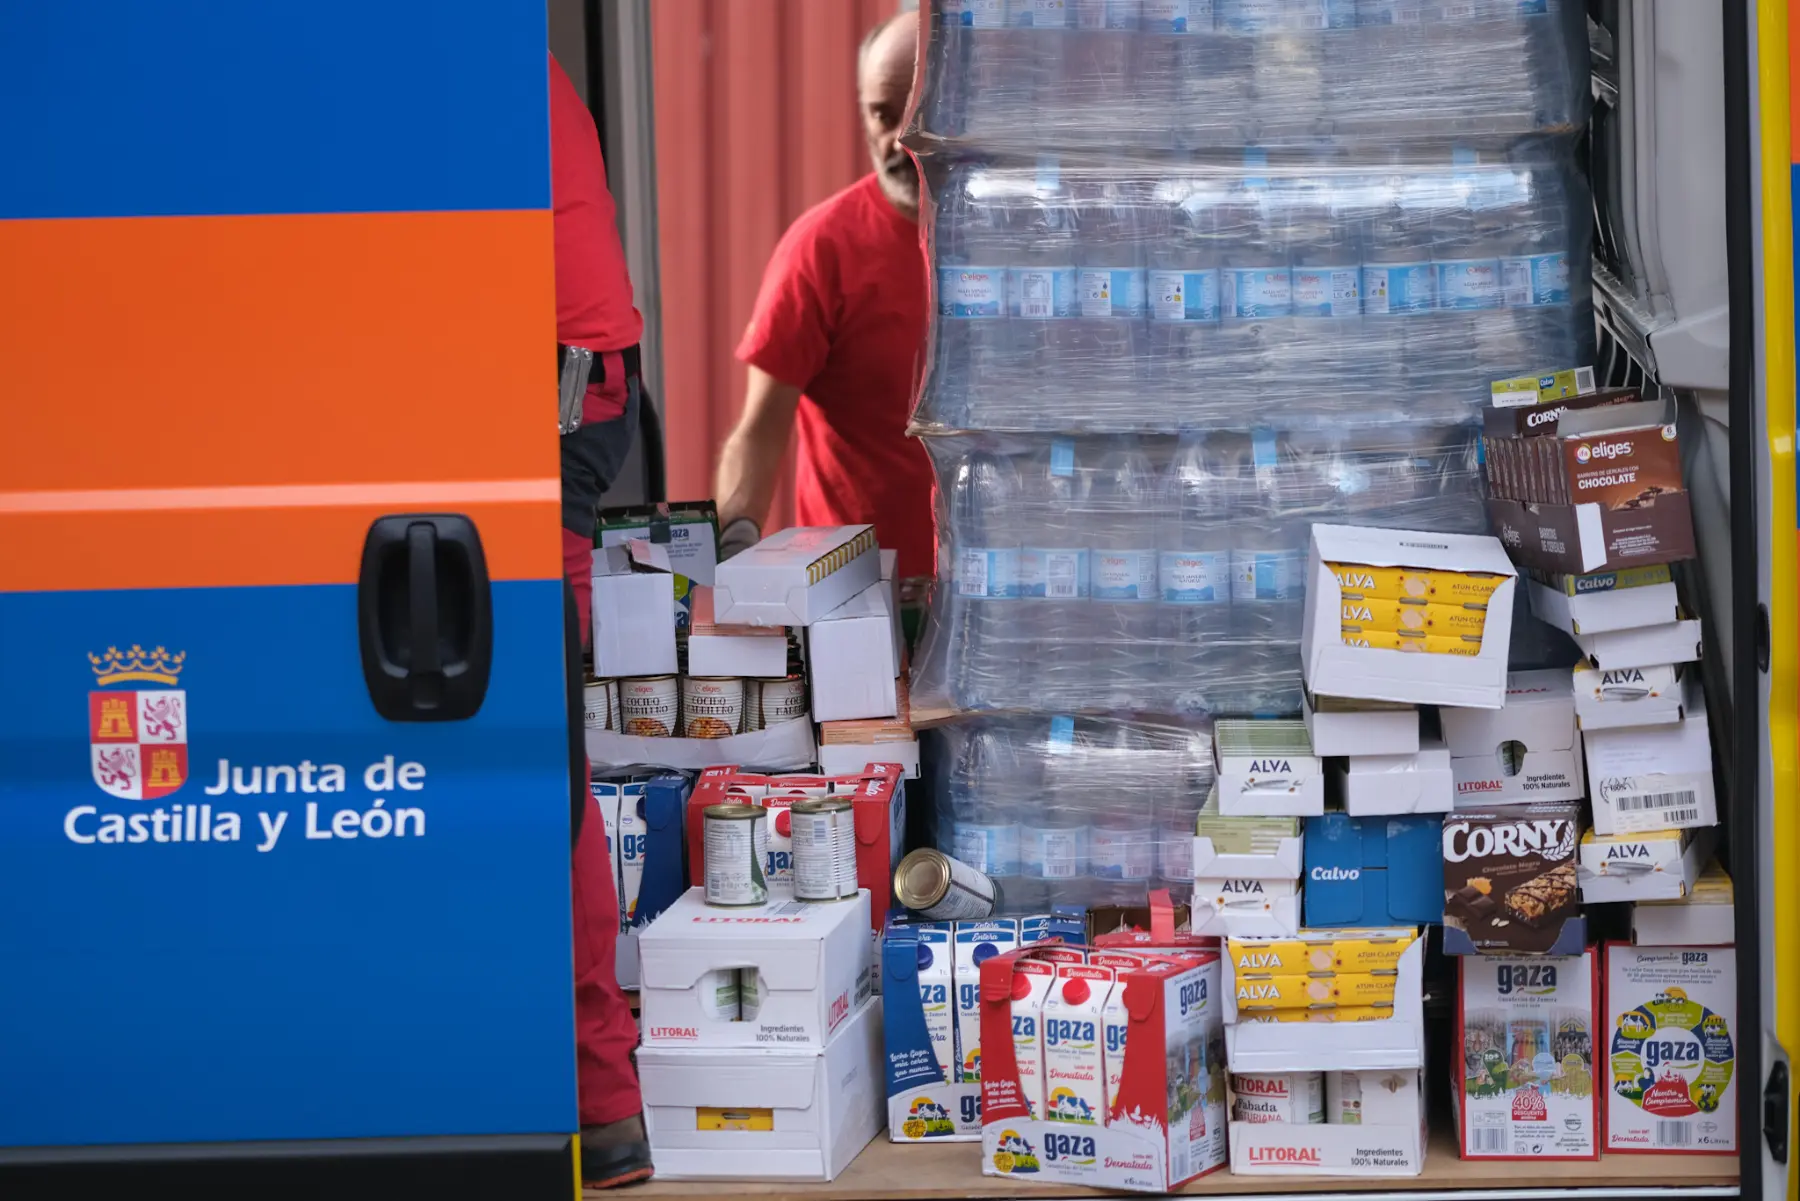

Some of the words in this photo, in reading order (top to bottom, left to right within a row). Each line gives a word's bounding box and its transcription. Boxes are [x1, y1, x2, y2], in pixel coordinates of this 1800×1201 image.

[1592, 442, 1632, 459] eliges
[1578, 473, 1636, 490] CHOCOLATE
[672, 528, 689, 538] aza
[1576, 575, 1614, 590] Calvo
[1343, 605, 1373, 621] LVA
[1601, 669, 1645, 685] ALVA
[1249, 760, 1292, 773] ALVA
[204, 758, 346, 796] Junta
[363, 755, 426, 791] de
[1526, 773, 1565, 782] Ingredientes
[1457, 781, 1503, 792] LITORAL
[1522, 782, 1540, 790] 100%
[1541, 781, 1571, 789] Naturales
[63, 804, 242, 844] Castilla
[256, 811, 288, 853] y
[305, 799, 426, 840] León
[1442, 819, 1566, 863] CORNY
[1607, 844, 1650, 859] ALVA
[1311, 867, 1360, 880] Calvo
[1221, 880, 1264, 894] ALVA
[972, 933, 998, 942] Entera
[1098, 957, 1134, 967] Desnatada
[1239, 953, 1283, 968] ALVA
[1682, 952, 1708, 965] gaza
[1066, 968, 1103, 979] Desnatada
[1497, 964, 1557, 995] gaza
[921, 984, 946, 1003] za
[1180, 978, 1207, 1016] gaza
[1237, 984, 1281, 1000] ALVA
[650, 1027, 698, 1037] LITORAL
[760, 1024, 805, 1034] Ingredientes
[1013, 1016, 1035, 1037] za
[1047, 1018, 1095, 1045] gaza
[756, 1034, 774, 1042] 100%
[776, 1034, 810, 1042] Naturales
[890, 1053, 909, 1063] Leche
[1646, 1041, 1700, 1067] gaza
[911, 1058, 929, 1066] cerca
[1049, 1069, 1094, 1082] Desnatada
[984, 1080, 999, 1089] Leche
[1237, 1097, 1278, 1113] Fabada
[1513, 1096, 1545, 1110] 40%
[1612, 1133, 1649, 1143] Desnatada
[1044, 1132, 1096, 1161] gaza
[1356, 1148, 1403, 1158] Ingredientes
[1248, 1147, 1321, 1161] LITORAL
[1104, 1157, 1153, 1171] Desnatada
[1351, 1157, 1371, 1166] 100%
[1373, 1157, 1409, 1166] Naturales
